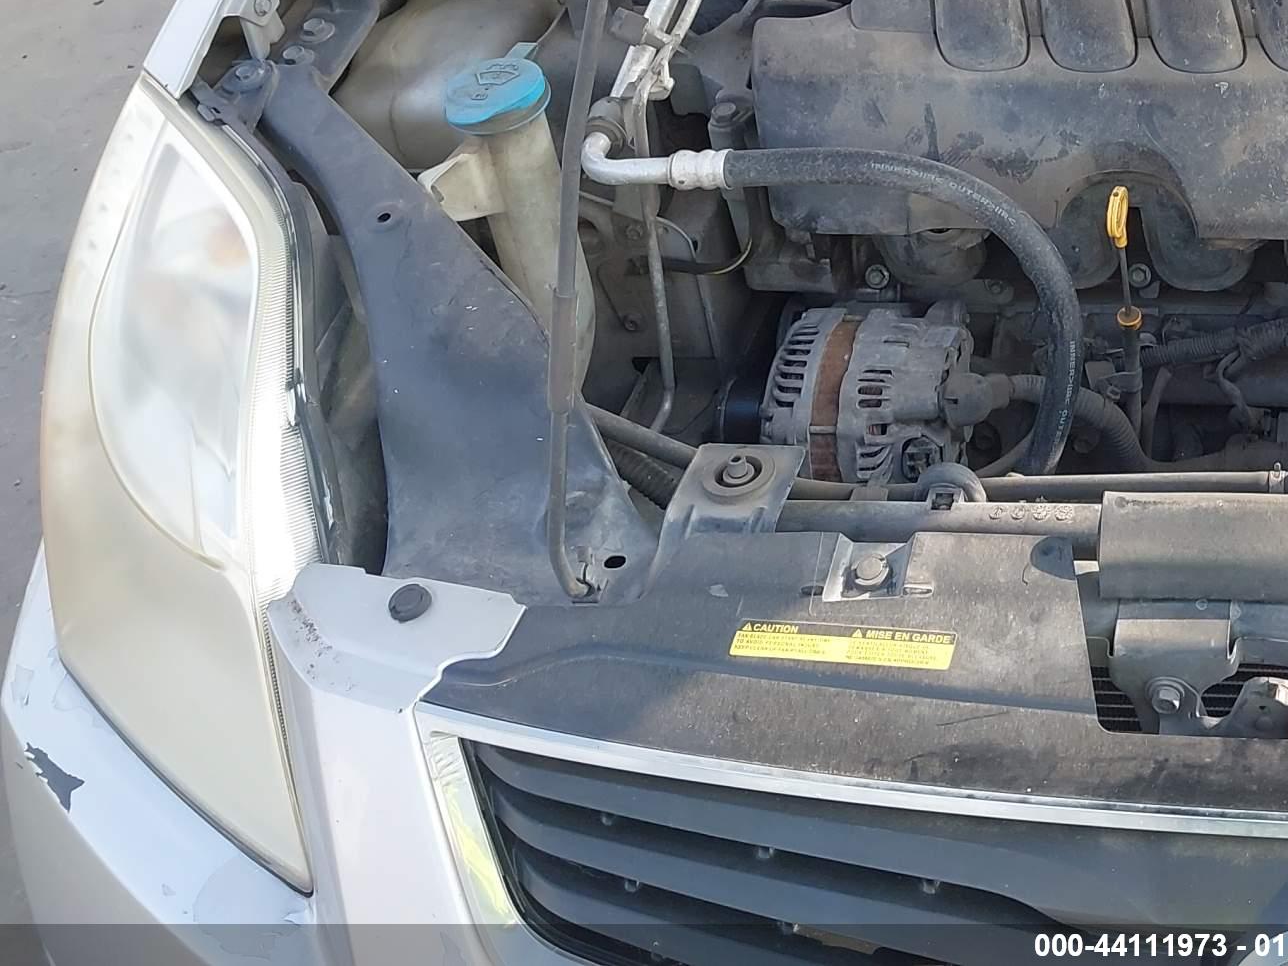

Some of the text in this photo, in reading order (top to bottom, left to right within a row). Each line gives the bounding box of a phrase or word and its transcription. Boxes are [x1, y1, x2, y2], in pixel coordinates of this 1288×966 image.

[753, 623, 799, 633] CAUTION
[865, 629, 953, 644] MISE EN GARDE
